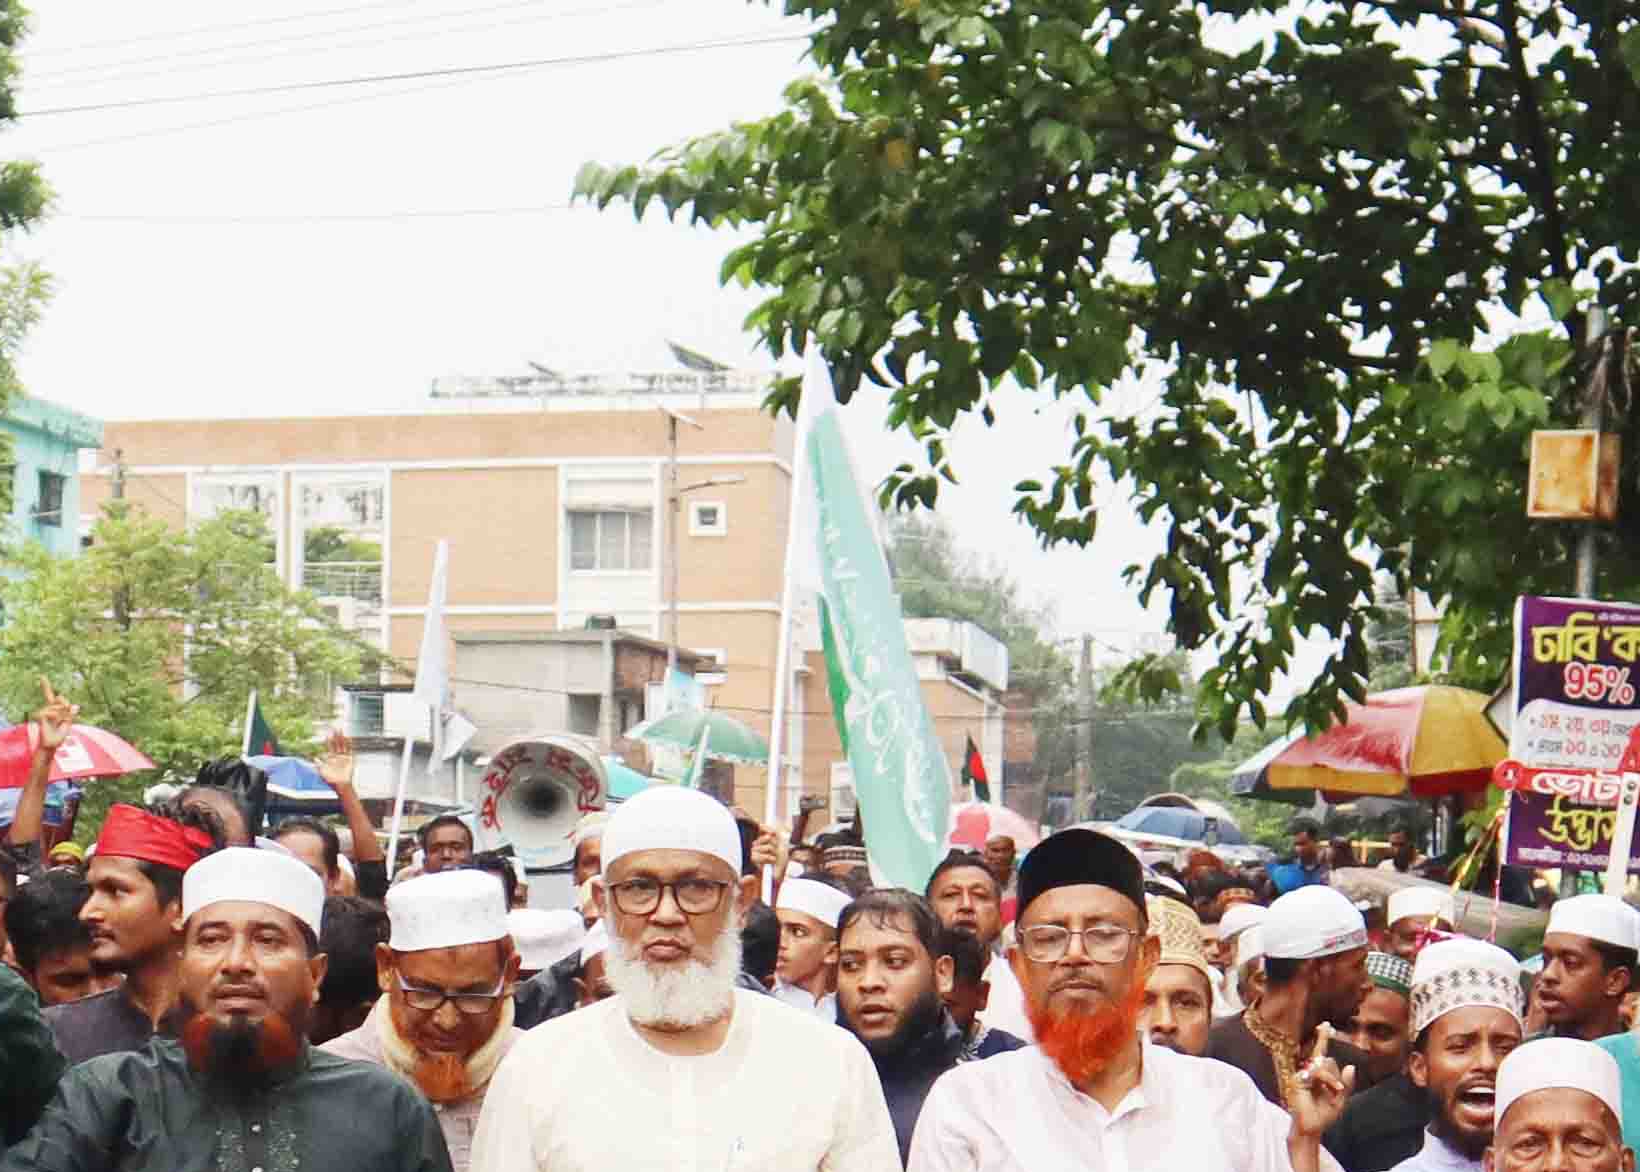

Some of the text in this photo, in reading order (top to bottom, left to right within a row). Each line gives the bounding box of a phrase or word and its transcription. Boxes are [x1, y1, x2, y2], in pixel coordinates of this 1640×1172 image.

[1531, 611, 1601, 663] ঢাবি
[1563, 659, 1636, 706] 95%
[1531, 770, 1622, 802] ভোট
